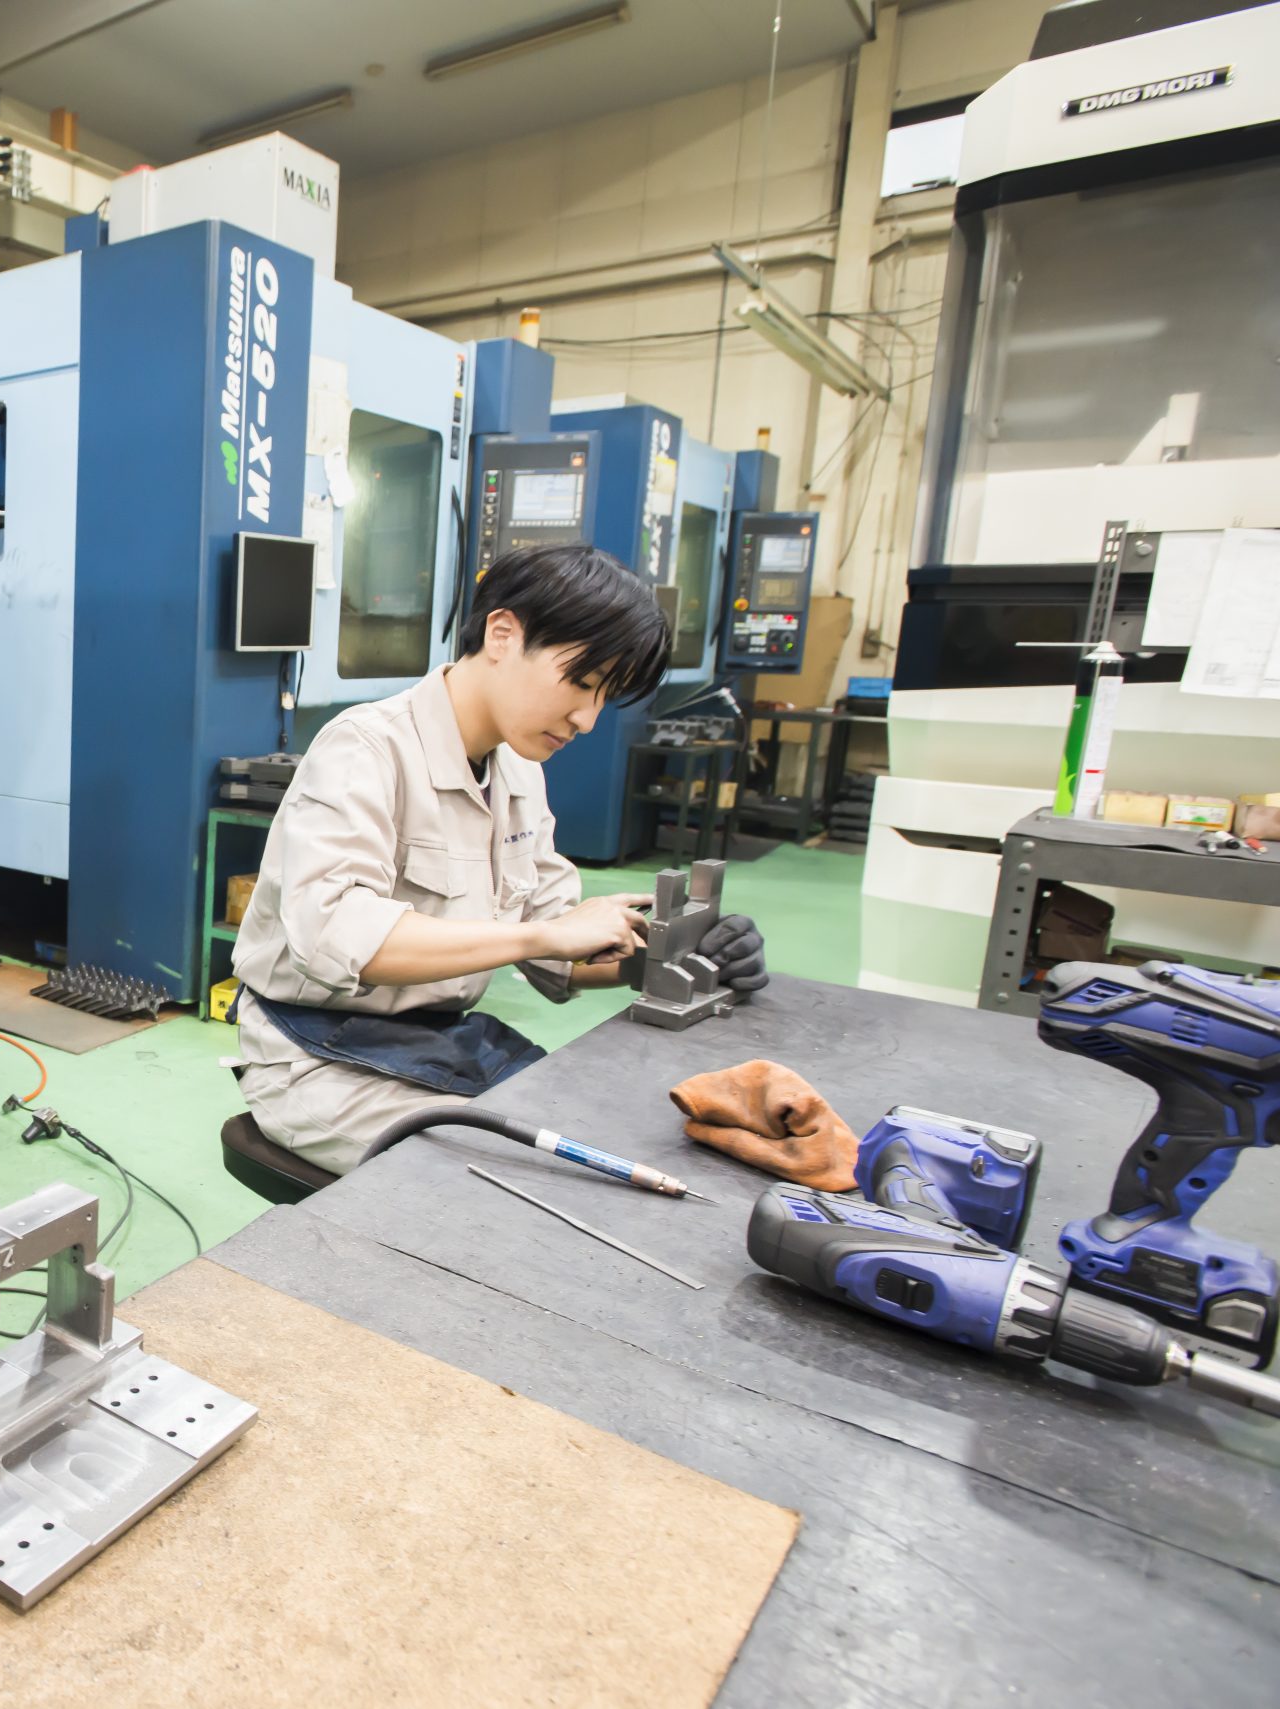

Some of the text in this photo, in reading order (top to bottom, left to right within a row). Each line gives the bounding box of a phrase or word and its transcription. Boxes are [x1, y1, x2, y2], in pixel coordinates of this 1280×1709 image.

[1079, 71, 1217, 114] DMG MORI
[282, 166, 331, 209] MAXIA
[220, 246, 246, 440] Matsuura
[246, 257, 279, 524] MX-520
